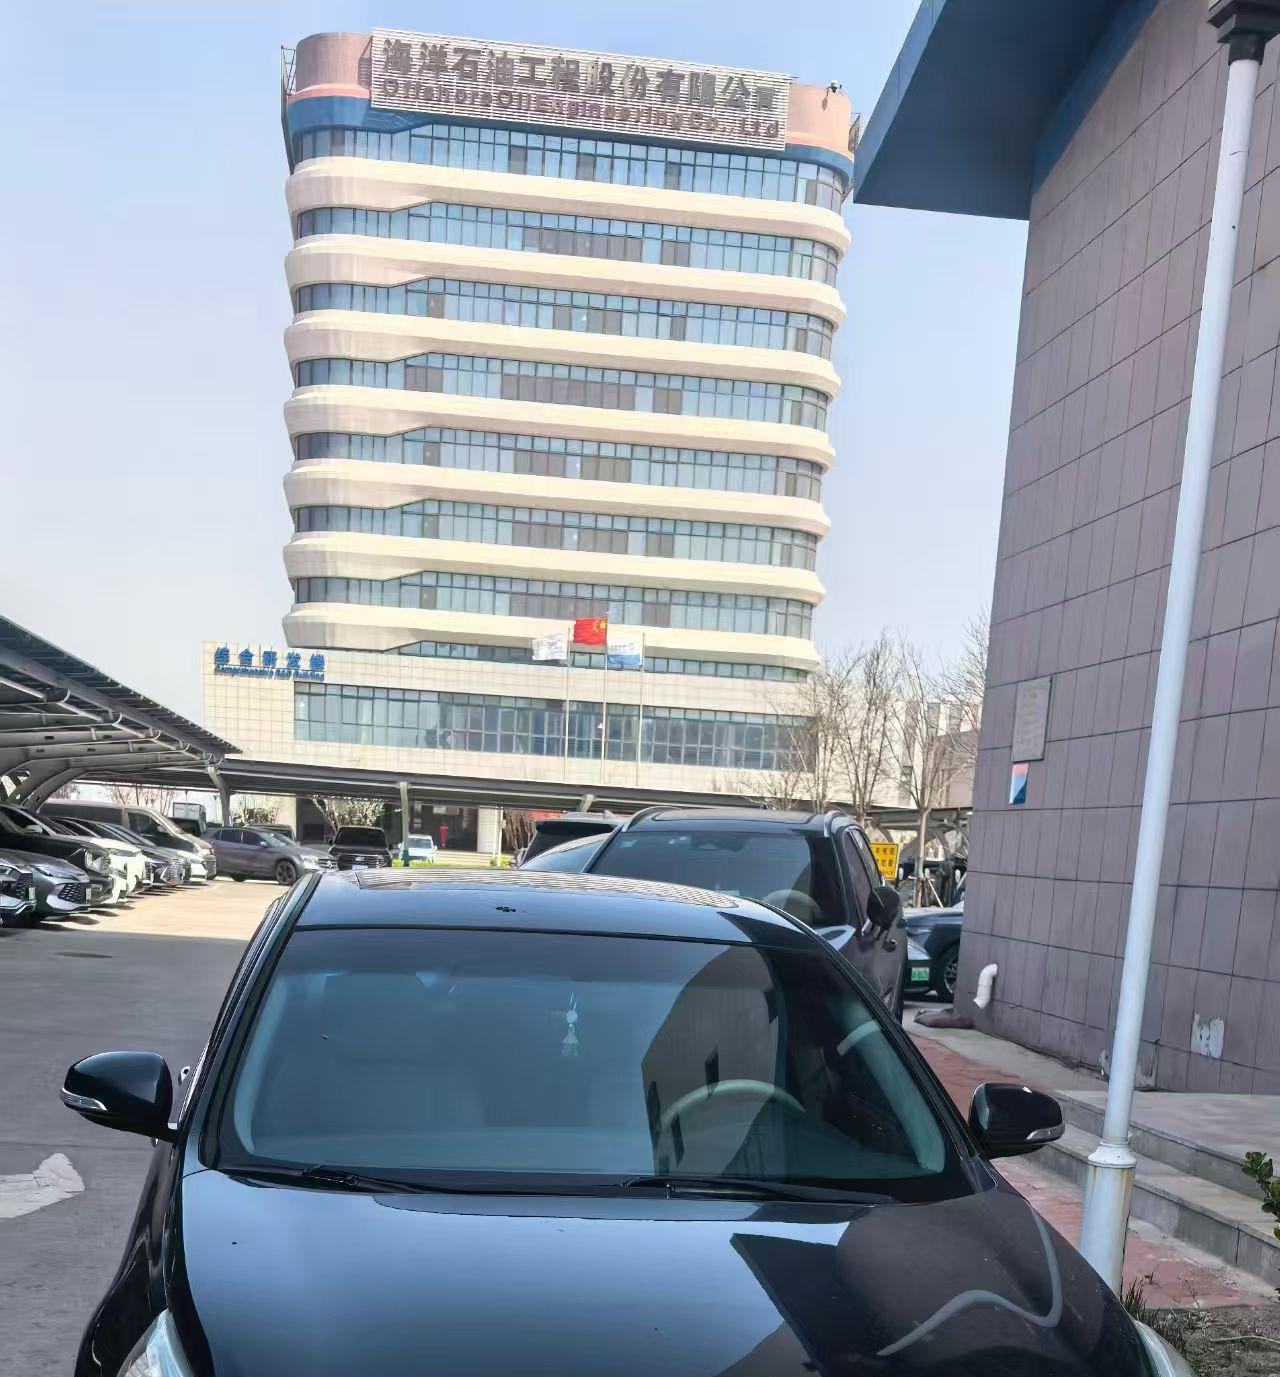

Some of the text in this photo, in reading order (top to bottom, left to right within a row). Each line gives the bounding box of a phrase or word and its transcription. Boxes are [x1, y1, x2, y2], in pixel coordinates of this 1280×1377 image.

[382, 36, 776, 112] 海洋石油工程股份有限公司
